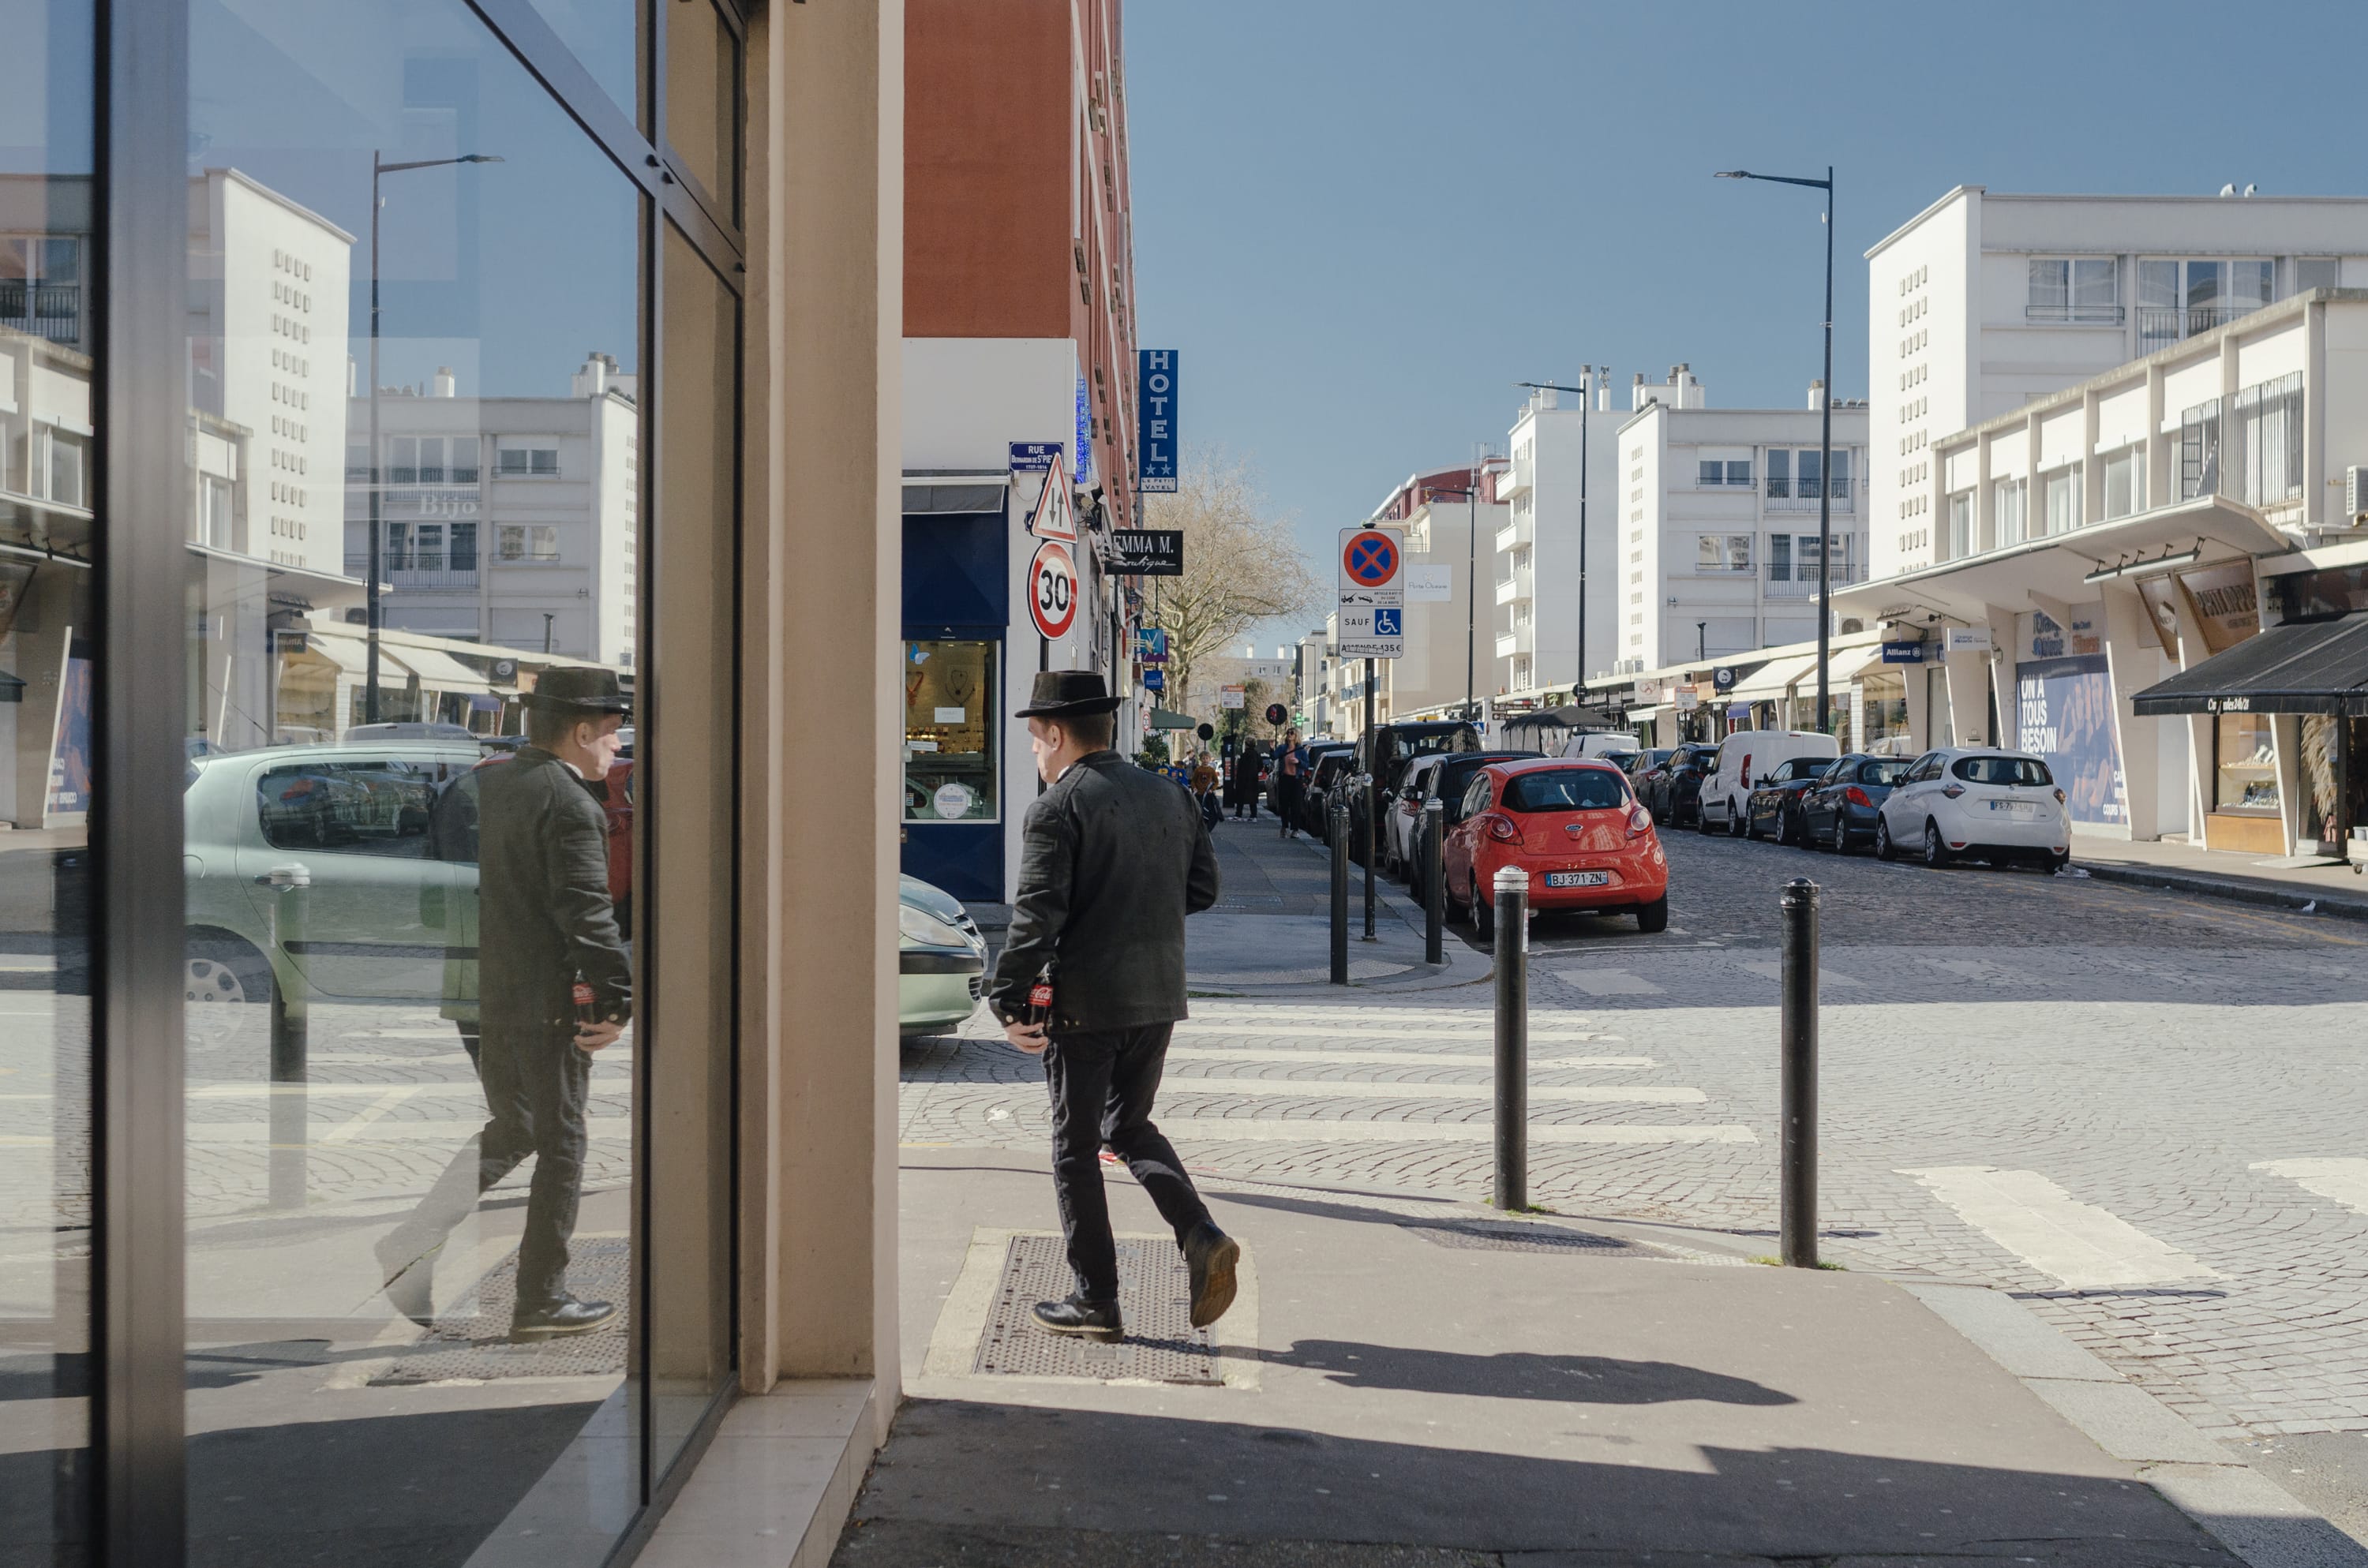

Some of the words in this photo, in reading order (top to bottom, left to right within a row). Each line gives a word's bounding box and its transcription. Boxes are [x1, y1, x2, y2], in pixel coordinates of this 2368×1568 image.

[1149, 351, 1169, 462] HOTEL
[1029, 445, 1044, 454] RUE
[1040, 570, 1070, 612] 30
[2021, 675, 2036, 700] ON
[2037, 673, 2044, 698] A
[2022, 701, 2047, 726] TOUS
[2021, 727, 2056, 753] BESOIN
[2103, 803, 2119, 816] COURS
